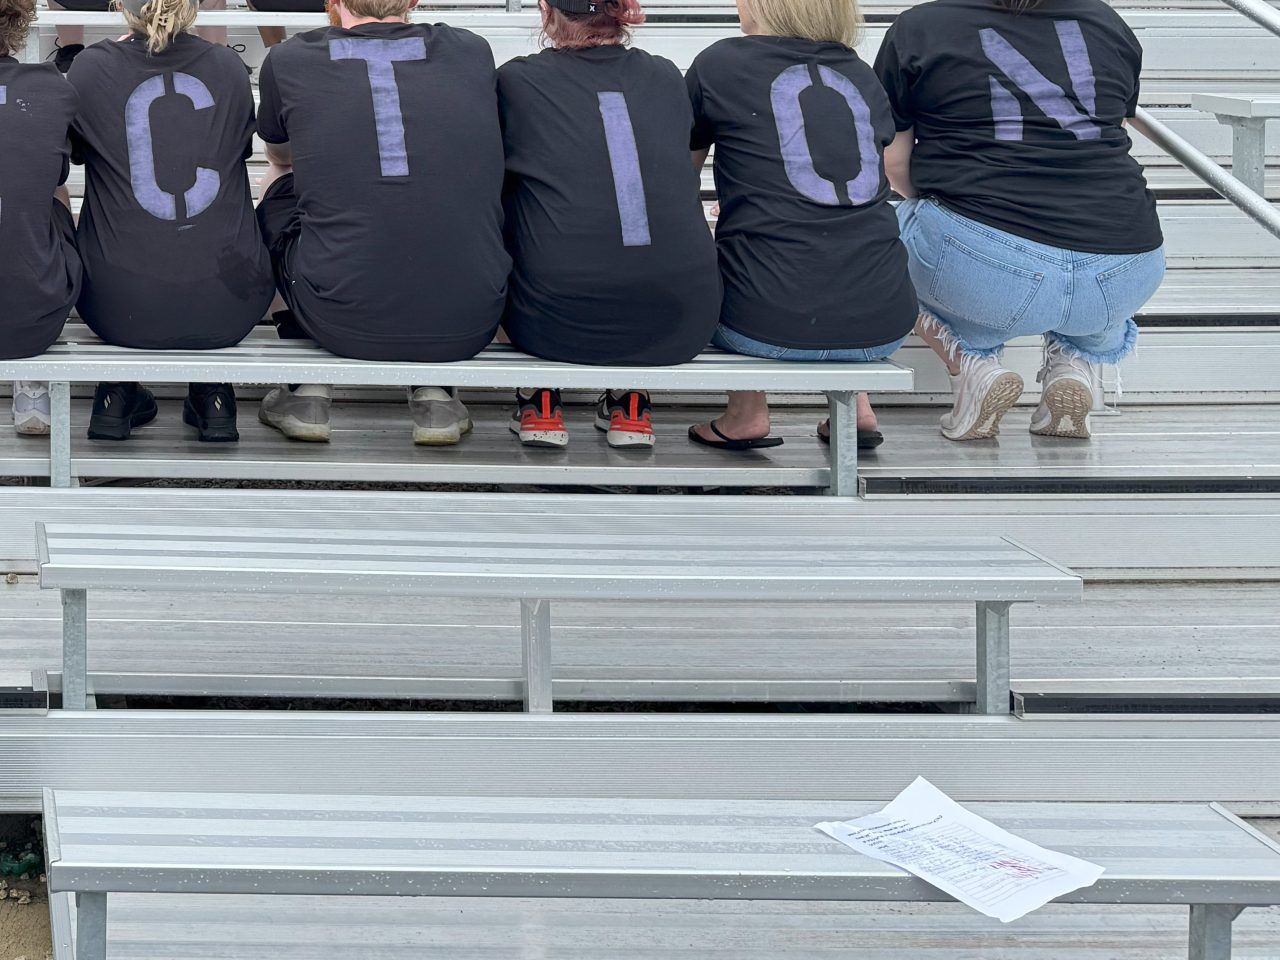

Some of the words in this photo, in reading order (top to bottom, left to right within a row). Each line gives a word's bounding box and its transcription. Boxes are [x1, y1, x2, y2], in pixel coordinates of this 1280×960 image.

[124, 72, 221, 221] C
[328, 36, 427, 177] T
[770, 62, 881, 206] O
[978, 19, 1102, 141] N
[597, 90, 651, 247] I
